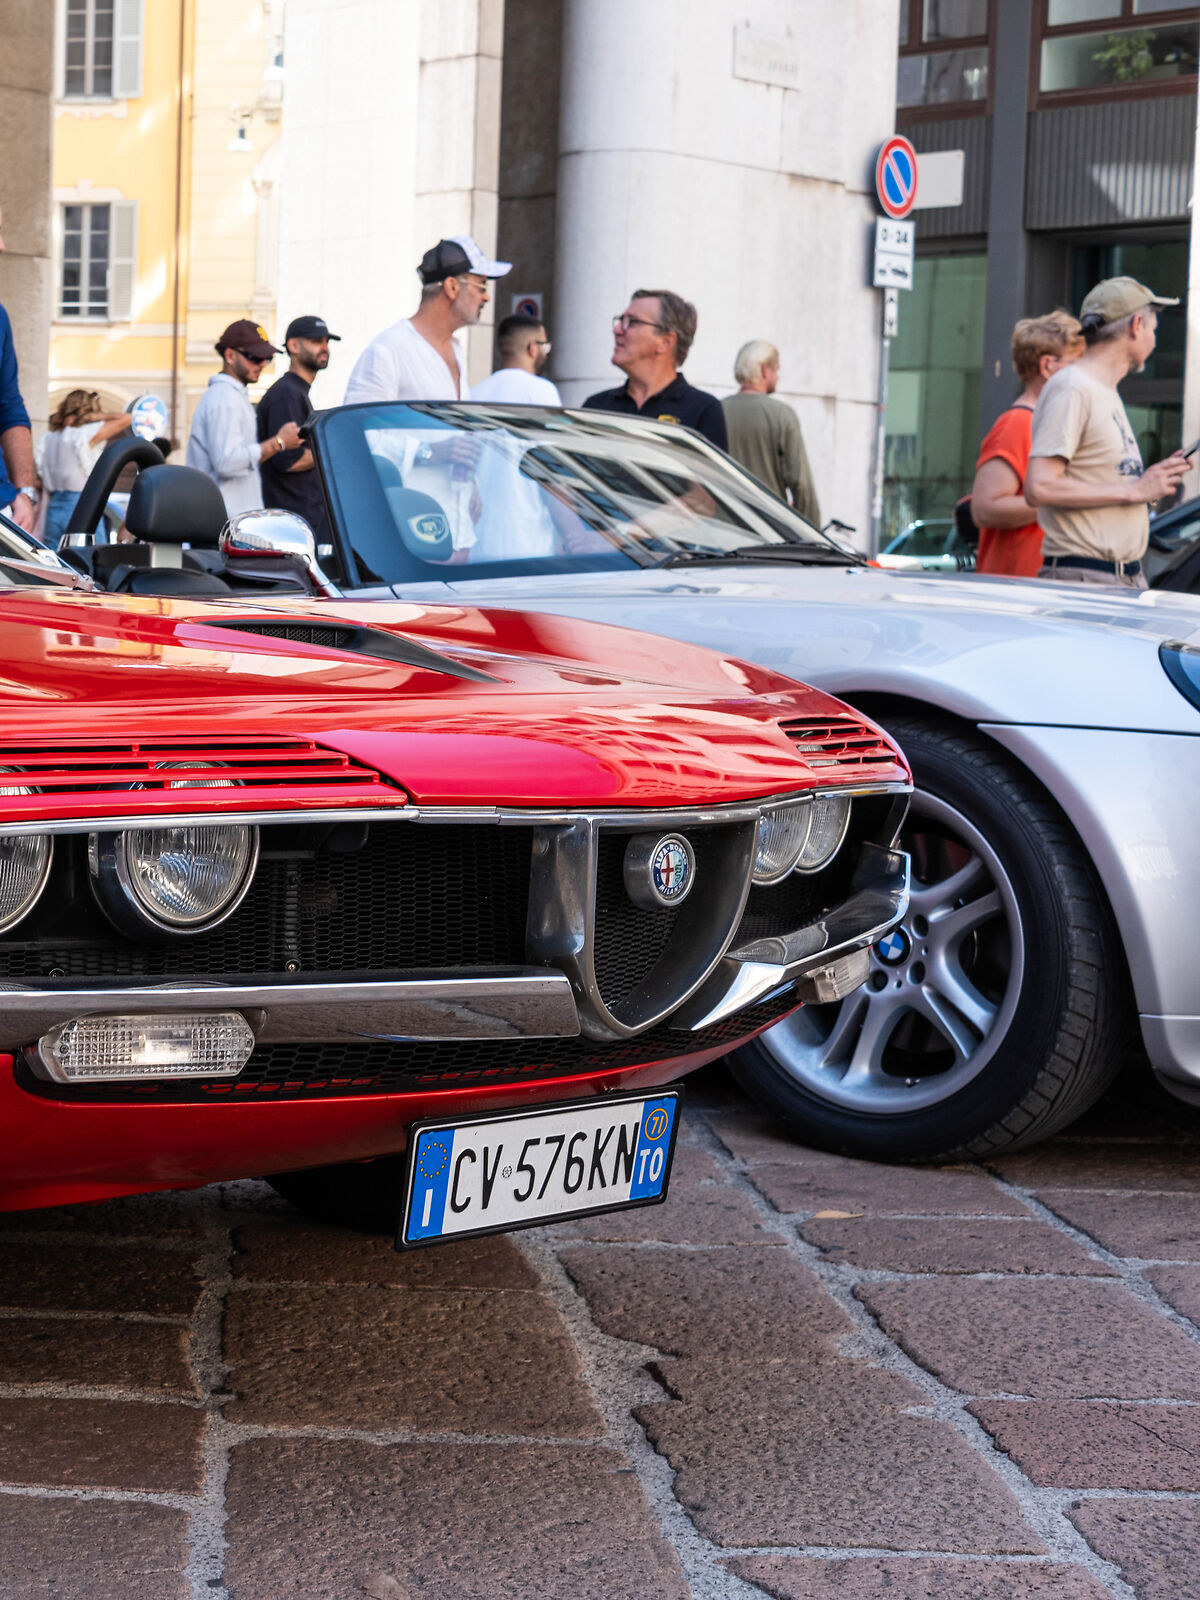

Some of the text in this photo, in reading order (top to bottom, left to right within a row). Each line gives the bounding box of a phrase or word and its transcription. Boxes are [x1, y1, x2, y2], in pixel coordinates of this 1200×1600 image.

[651, 1116, 663, 1134] 71
[450, 1144, 504, 1213] CV
[513, 1122, 640, 1201] 576KN
[638, 1147, 664, 1185] TO
